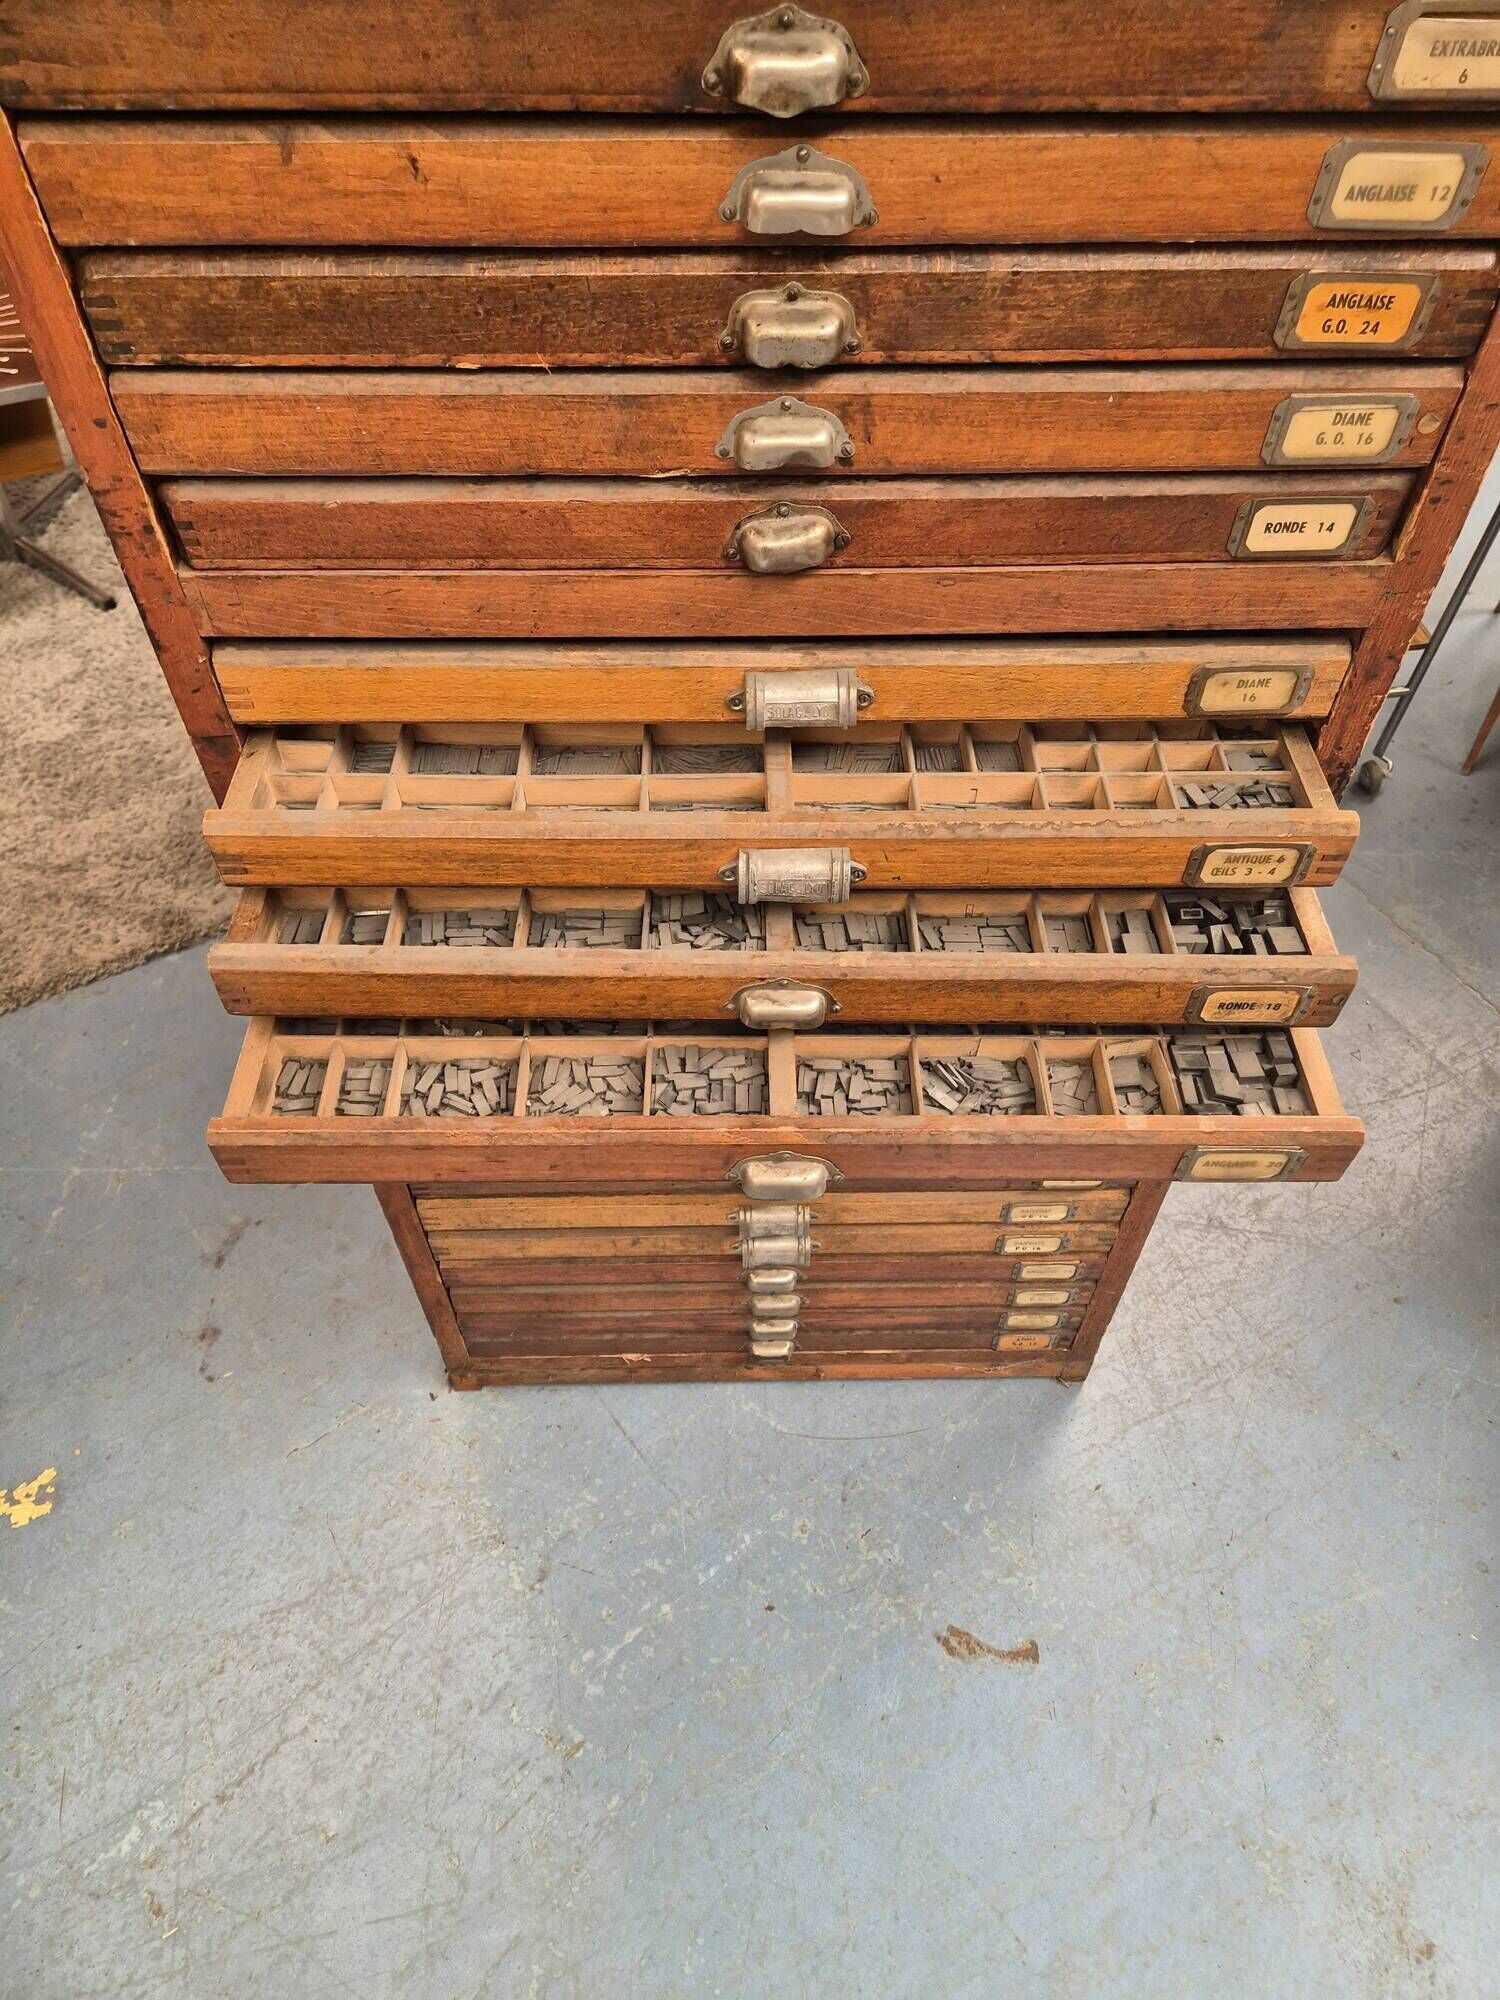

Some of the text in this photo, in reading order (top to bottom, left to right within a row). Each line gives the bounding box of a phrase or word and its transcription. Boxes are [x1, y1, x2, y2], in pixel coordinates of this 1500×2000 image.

[1458, 68, 1468, 84] 6
[1344, 184, 1451, 201] ANGLAISE 12
[1326, 293, 1396, 311] ANGLAISE
[1321, 318, 1380, 335] G.O. 24
[1331, 412, 1375, 426] DIANE
[1356, 432, 1374, 445] 16
[1263, 521, 1335, 534] RONDE 14
[1236, 678, 1272, 689] DIANE
[1242, 692, 1257, 702] 16
[1224, 855, 1274, 865] ANTIQUE
[1244, 867, 1253, 876] 3
[1267, 867, 1277, 876] 4
[1217, 1002, 1257, 1011] RONDE
